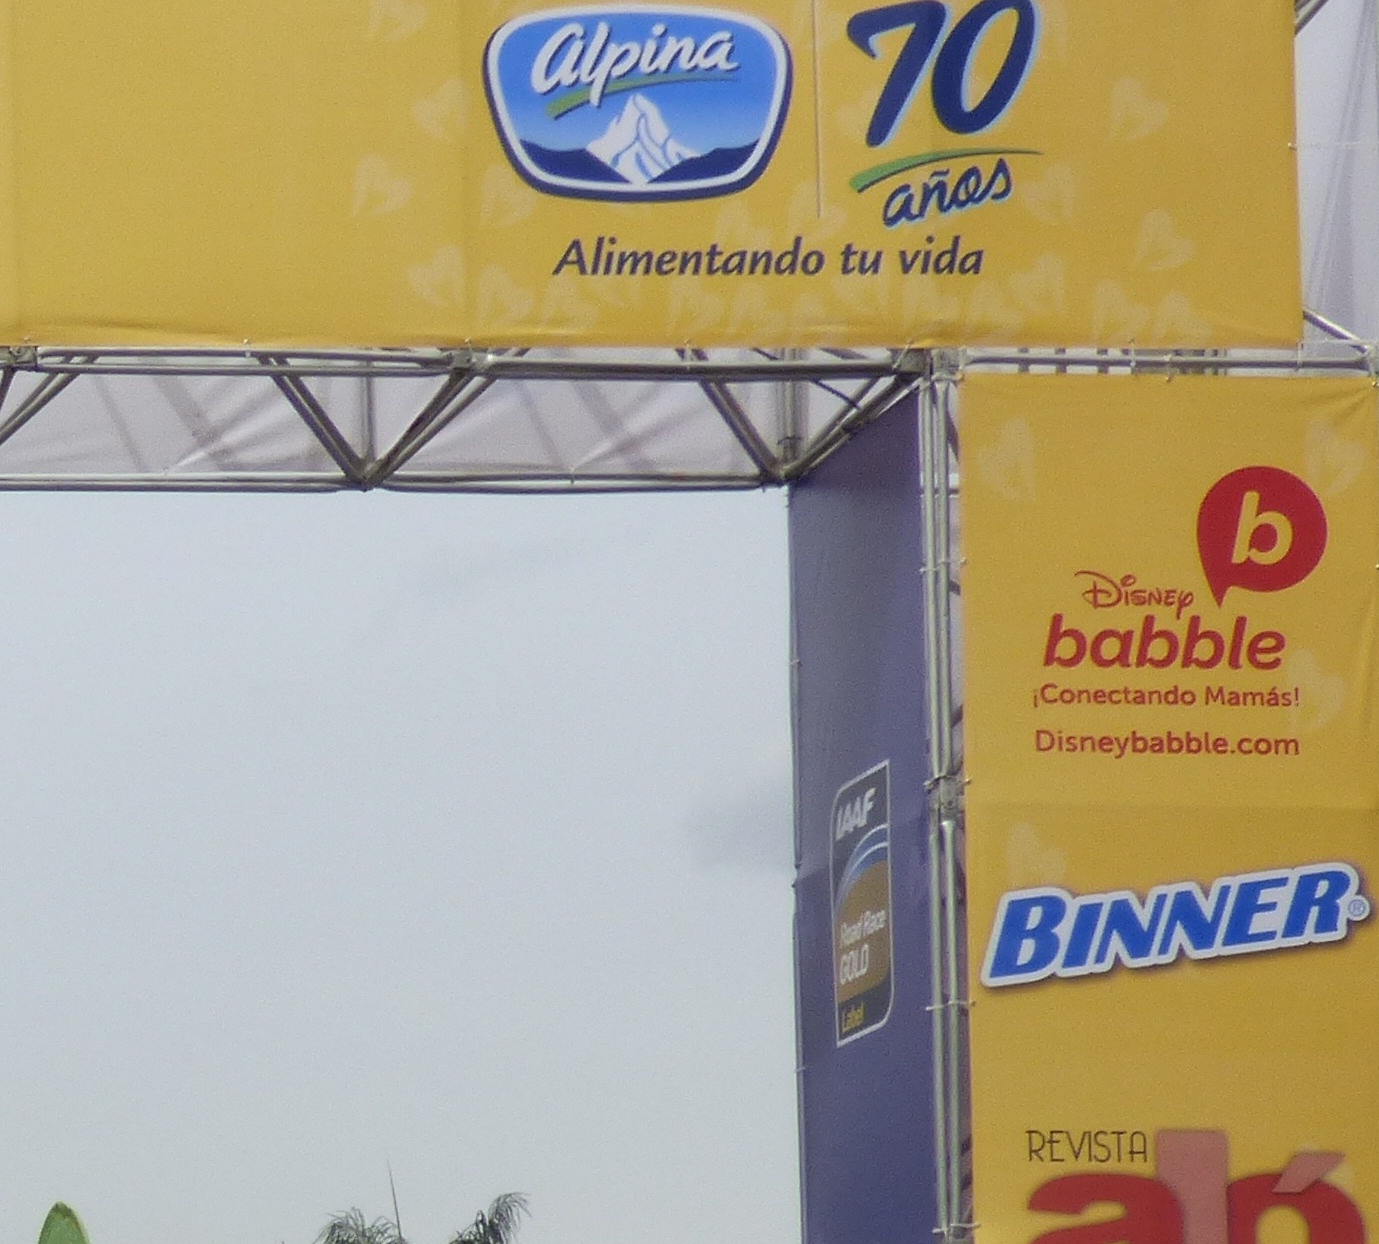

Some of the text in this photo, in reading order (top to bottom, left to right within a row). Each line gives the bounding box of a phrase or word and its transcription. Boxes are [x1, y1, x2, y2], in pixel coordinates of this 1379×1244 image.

[531, 22, 738, 107] Alpina
[847, 0, 1038, 149] 70
[882, 157, 1013, 228] años
[553, 236, 984, 277] Alimentando tu vida
[1231, 490, 1293, 565] b
[1043, 613, 1287, 670] babble
[1033, 683, 1301, 708] ¡Conectando Mamás!
[1035, 729, 1301, 759] Disneybabble.com
[835, 787, 877, 841] IAAF
[990, 870, 1352, 979] BINNER
[839, 944, 870, 986] GOLD
[1026, 1129, 1149, 1163] REVISTA
